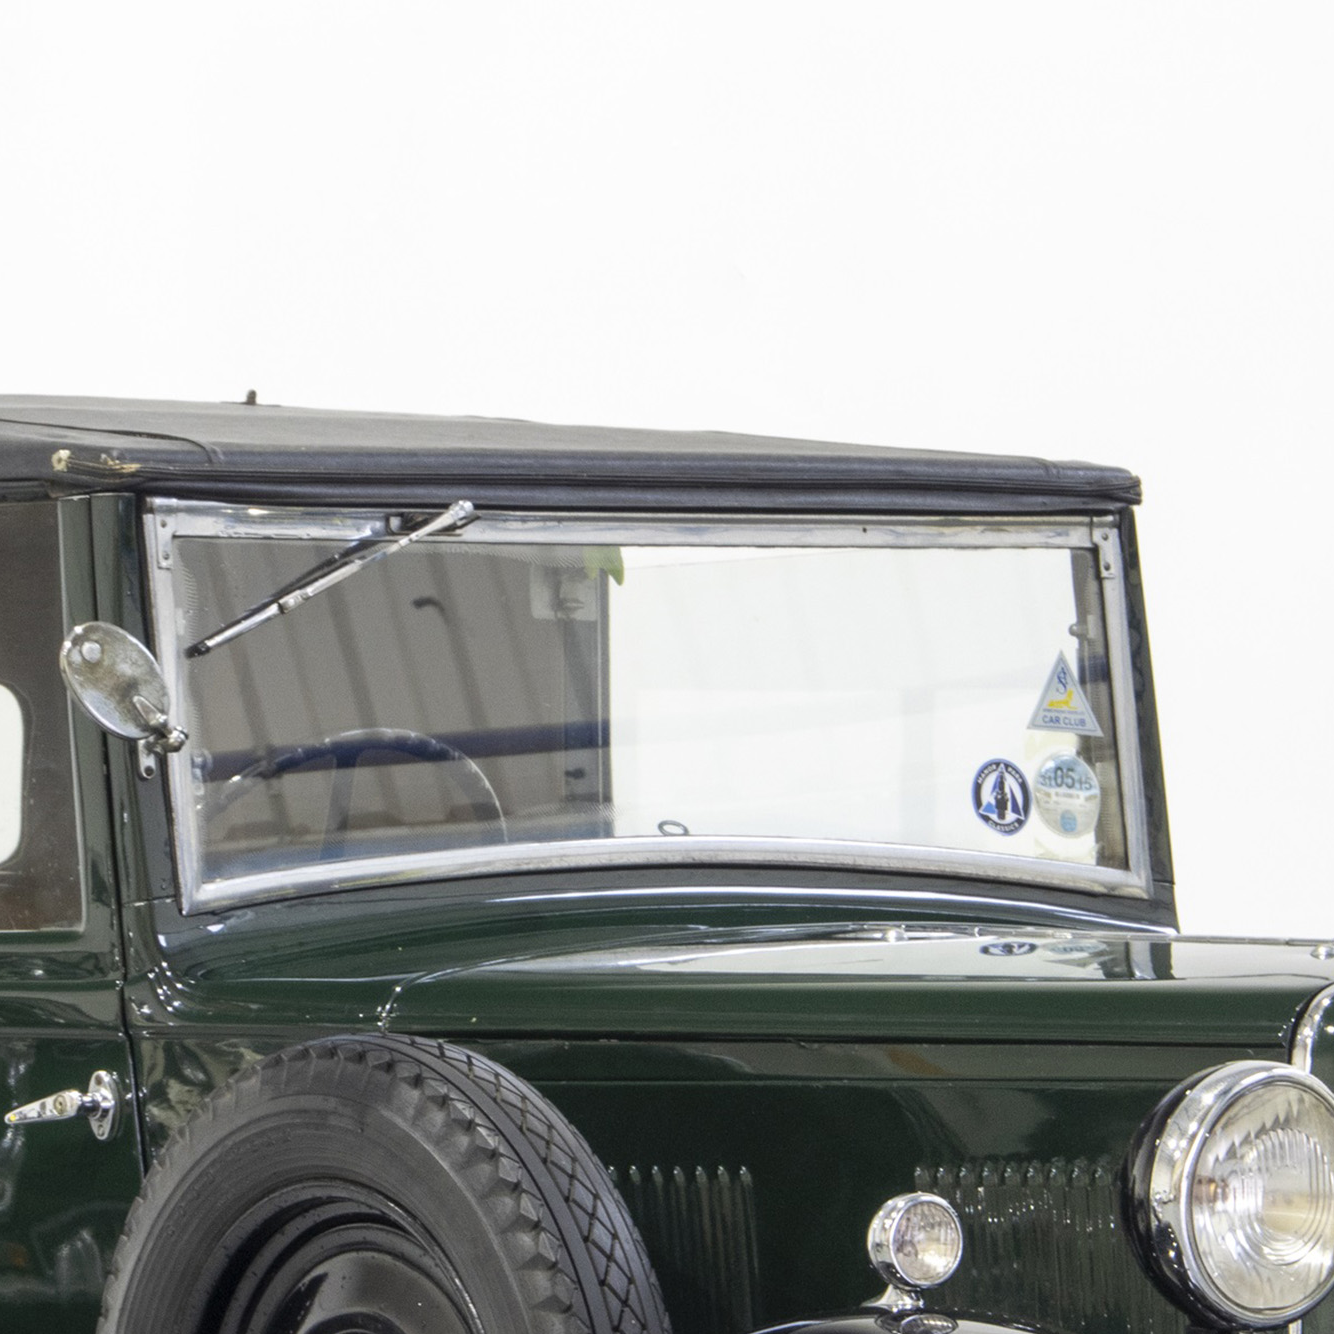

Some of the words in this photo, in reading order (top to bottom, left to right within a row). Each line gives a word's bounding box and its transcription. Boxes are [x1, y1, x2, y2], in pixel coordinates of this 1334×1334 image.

[1042, 715, 1061, 725] CAR
[1063, 717, 1087, 727] CLUB
[1054, 766, 1076, 789] 05
